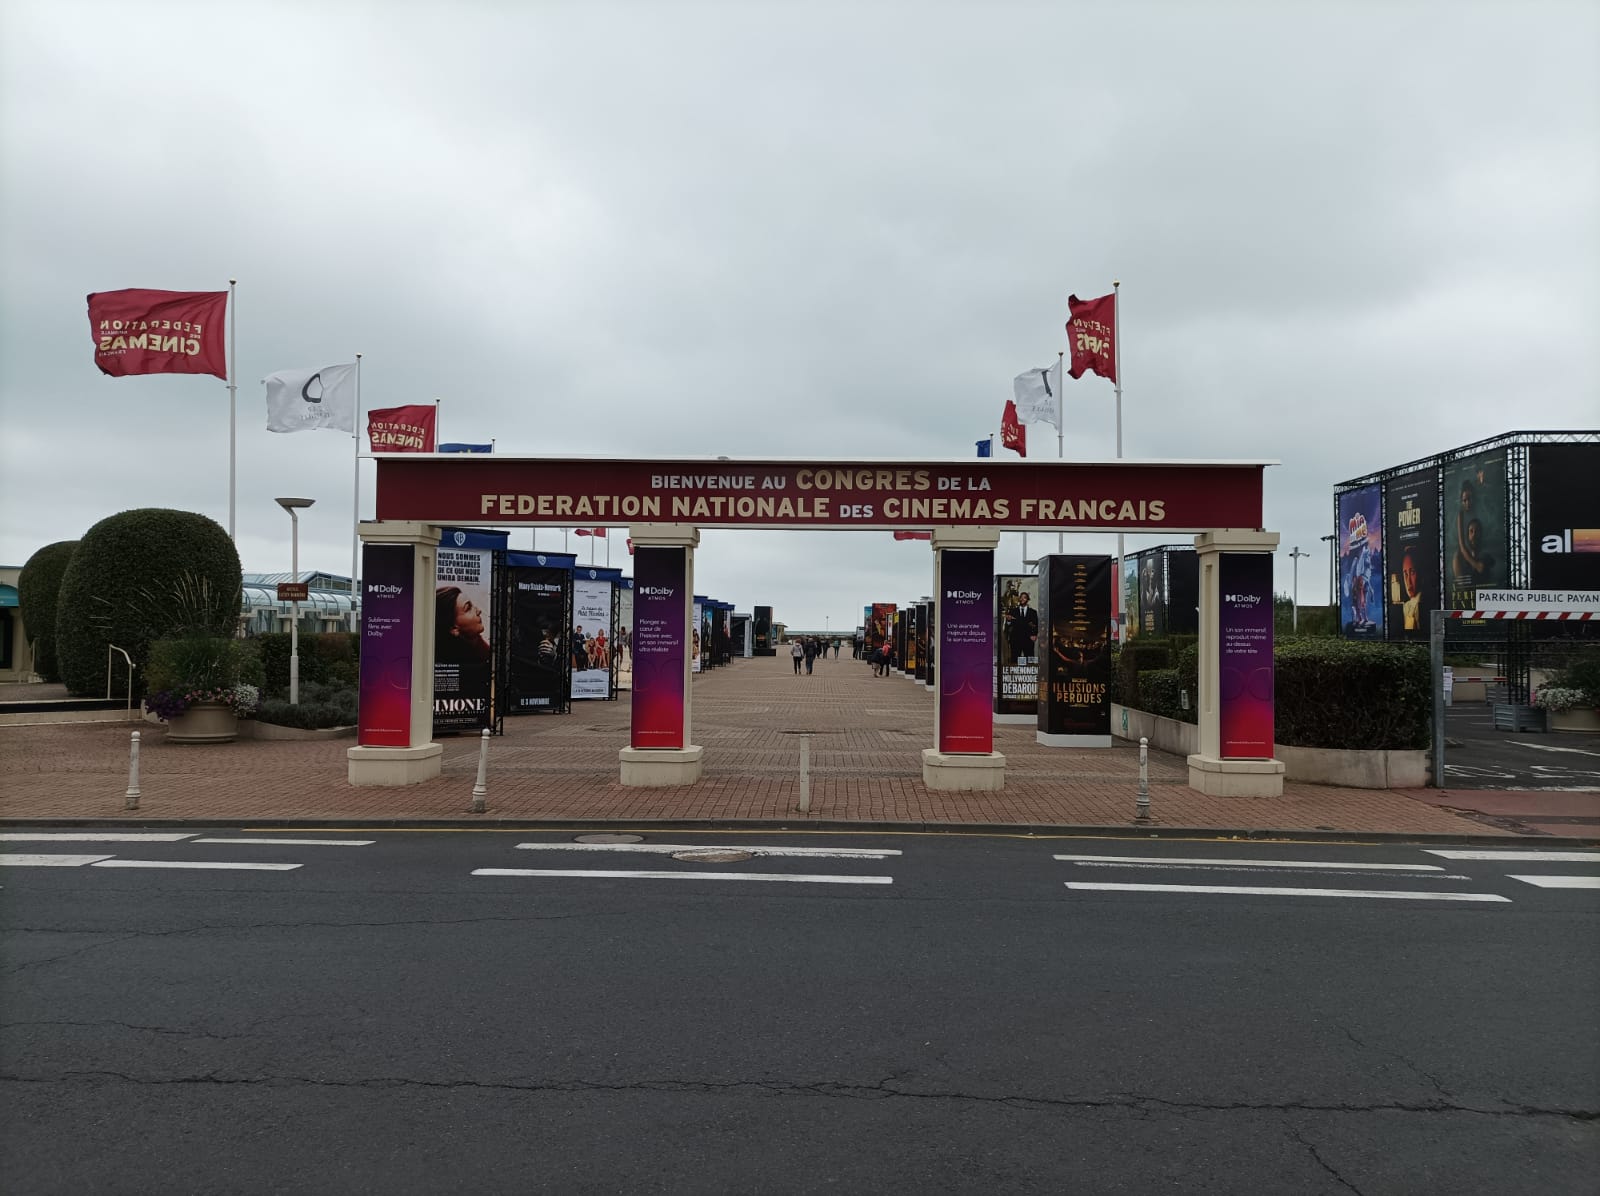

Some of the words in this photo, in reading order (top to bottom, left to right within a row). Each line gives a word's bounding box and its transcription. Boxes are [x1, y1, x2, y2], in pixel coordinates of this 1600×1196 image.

[651, 475, 755, 490] BIENVENUE
[761, 475, 786, 490] AU
[796, 469, 930, 491] CONGRES
[937, 476, 962, 491] DE
[967, 477, 992, 491] LA
[480, 494, 661, 517] FEDERATION
[671, 496, 830, 518] NATIONALE
[839, 504, 874, 518] DES
[883, 498, 1010, 520] CINEMAS
[1020, 499, 1166, 521] FRANCAIS
[1398, 507, 1421, 528] POWER
[437, 552, 454, 560] NOUS
[455, 553, 481, 562] SOMMES
[437, 560, 481, 569] RESPONSABLES
[380, 584, 403, 595] Dolby
[650, 586, 674, 597] Dolby
[958, 590, 982, 600] Dolby
[1237, 594, 1261, 605] Dolby
[1478, 592, 1524, 602] PARKING
[1527, 593, 1564, 603] PUBLIC
[1567, 594, 1599, 603] PAYAN
[1052, 682, 1106, 694] ILLUSIONS
[1056, 692, 1102, 704] PERDUES
